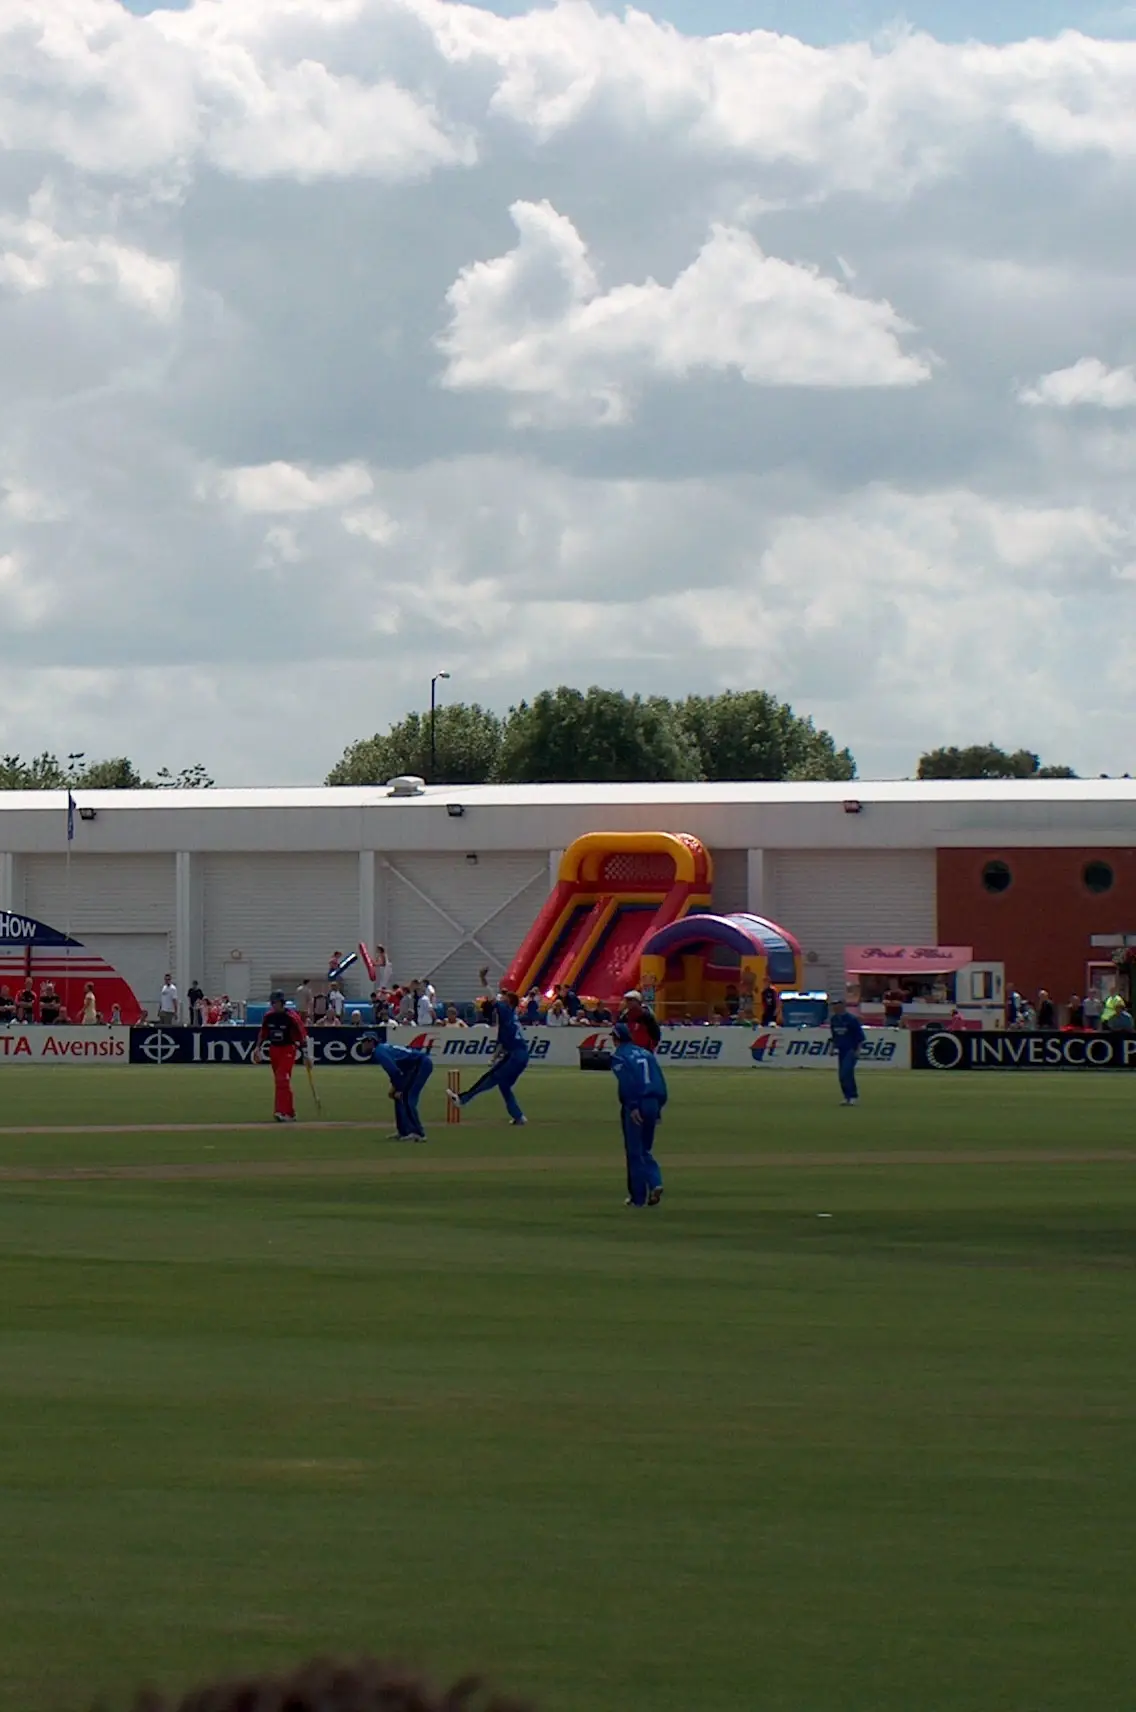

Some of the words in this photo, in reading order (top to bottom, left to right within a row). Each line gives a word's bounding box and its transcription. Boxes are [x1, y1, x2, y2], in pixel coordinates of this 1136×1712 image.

[41, 1036, 125, 1056] Avensis
[443, 1036, 551, 1055] malaia
[786, 1038, 896, 1056] malsia
[971, 1037, 1113, 1064] INVESCO
[637, 1058, 651, 1084] 7
